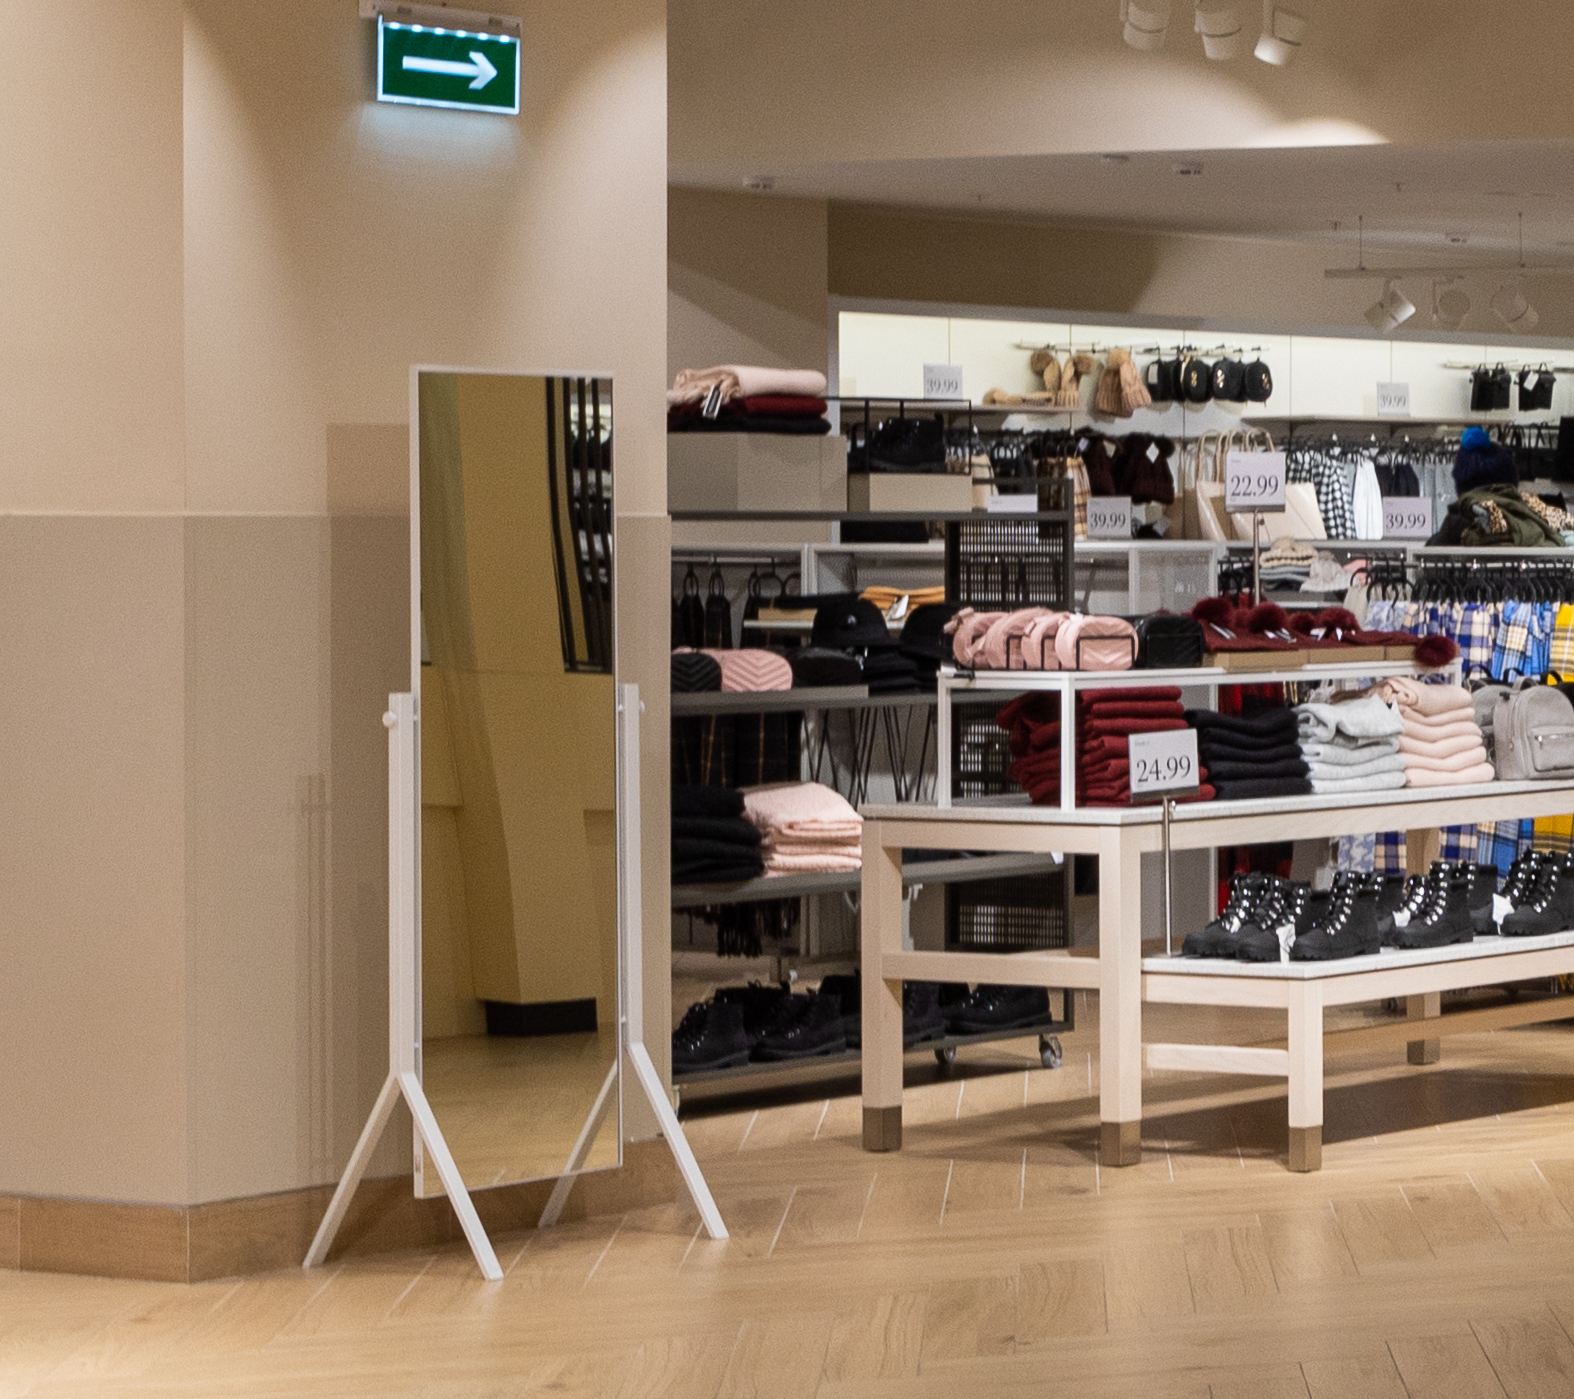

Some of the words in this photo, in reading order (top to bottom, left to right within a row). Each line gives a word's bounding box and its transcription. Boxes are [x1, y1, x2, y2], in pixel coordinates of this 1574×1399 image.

[1230, 474, 1279, 498] 22.99
[1090, 512, 1126, 530] 39.99
[1385, 512, 1427, 531] 39.99
[1136, 755, 1191, 783] 24.99
